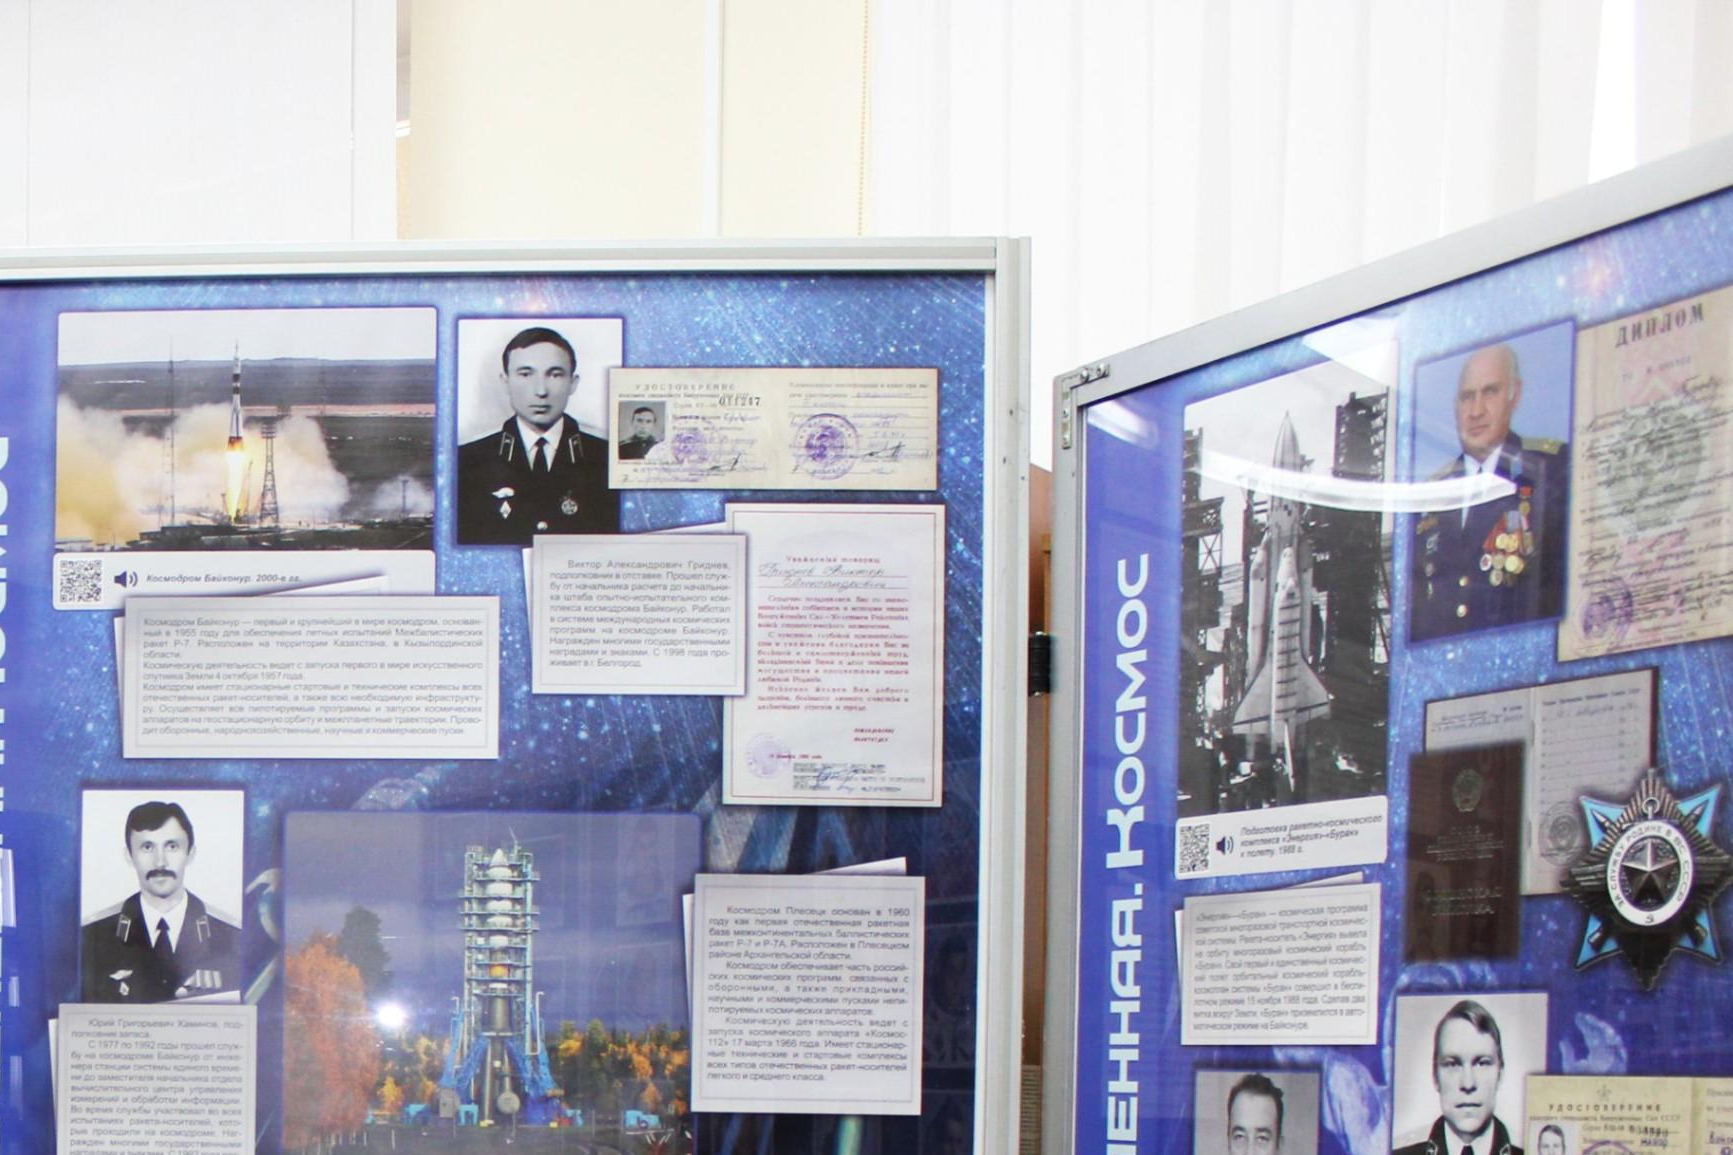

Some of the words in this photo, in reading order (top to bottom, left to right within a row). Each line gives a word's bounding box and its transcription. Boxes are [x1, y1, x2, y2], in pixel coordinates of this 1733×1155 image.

[1614, 303, 1704, 349] ДИПЛОМ
[146, 574, 201, 584] Космодром
[1548, 1104, 1662, 1112] УДОСТОВЕРЕНИЕ
